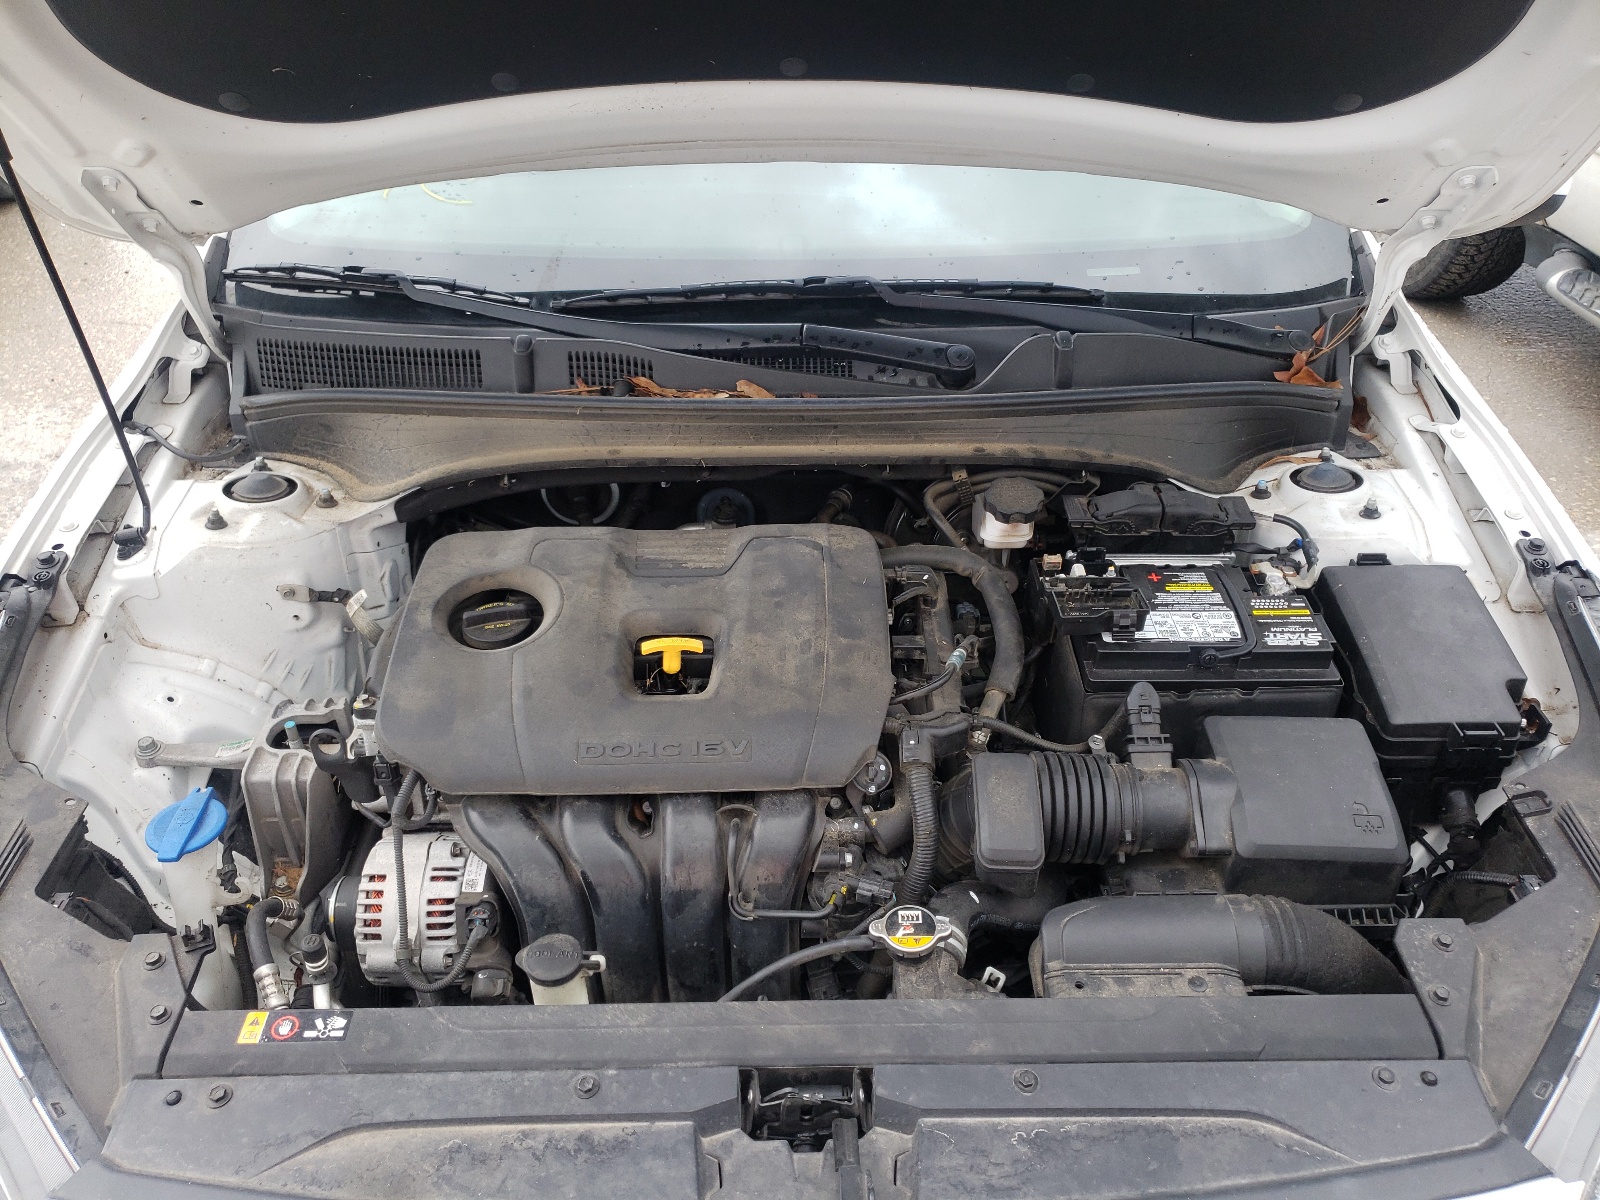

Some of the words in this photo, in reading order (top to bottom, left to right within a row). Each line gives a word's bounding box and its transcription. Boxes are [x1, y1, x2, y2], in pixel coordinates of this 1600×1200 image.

[1264, 633, 1322, 641] START
[579, 741, 682, 759] DOHC
[691, 738, 750, 757] 16V
